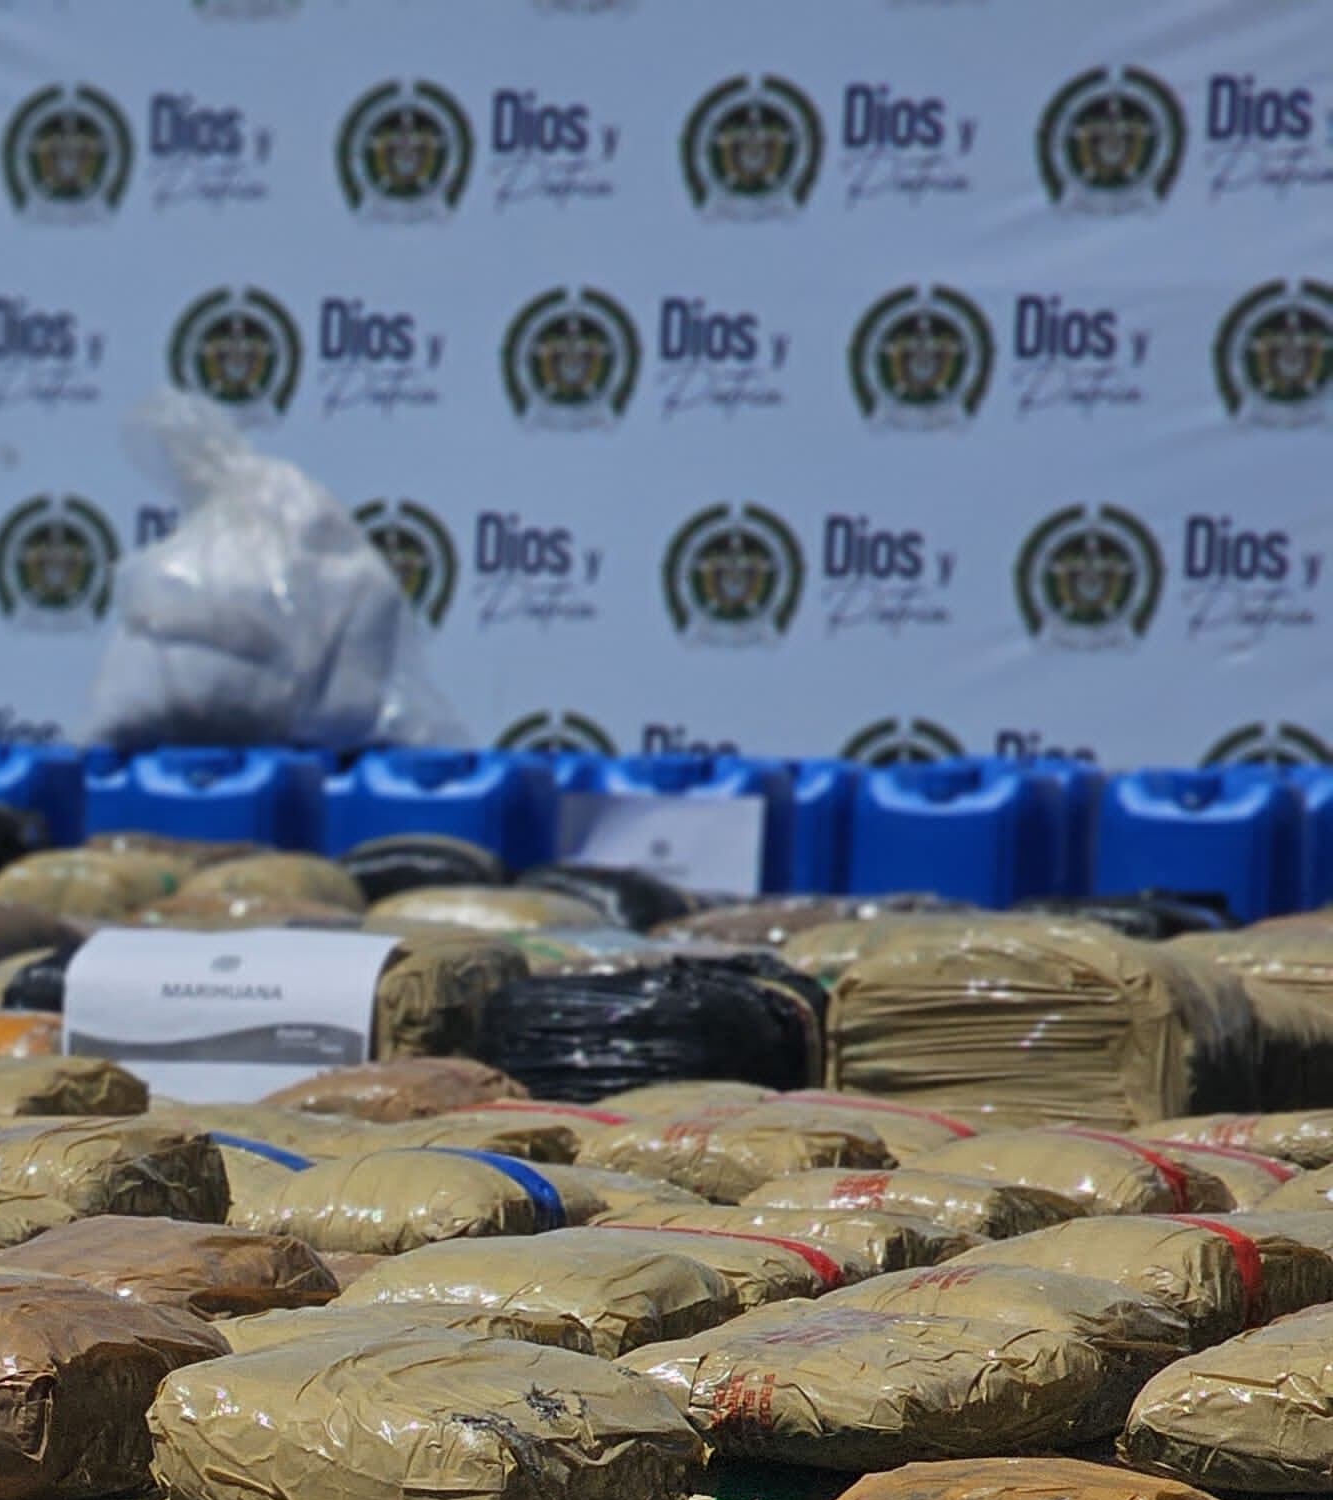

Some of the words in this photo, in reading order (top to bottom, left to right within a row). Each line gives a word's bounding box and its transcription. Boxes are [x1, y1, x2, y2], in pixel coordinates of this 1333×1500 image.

[149, 93, 243, 158] Dios
[255, 128, 272, 163] y
[491, 89, 589, 155] Dios
[603, 128, 619, 159] y
[843, 83, 944, 149] Dios
[959, 120, 976, 153] y
[1207, 74, 1312, 143] Dios
[320, 298, 415, 362] Dios
[427, 336, 443, 368] y
[659, 297, 757, 362] Dios
[771, 336, 789, 368] y
[1014, 295, 1117, 361] Dios
[1131, 333, 1149, 365] y
[475, 512, 572, 577] Dios
[585, 551, 601, 583] y
[823, 515, 923, 580] Dios
[938, 554, 954, 586] y
[1183, 515, 1289, 583] Dios
[1304, 555, 1321, 588] y
[161, 982, 282, 1001] MARIHUANA
